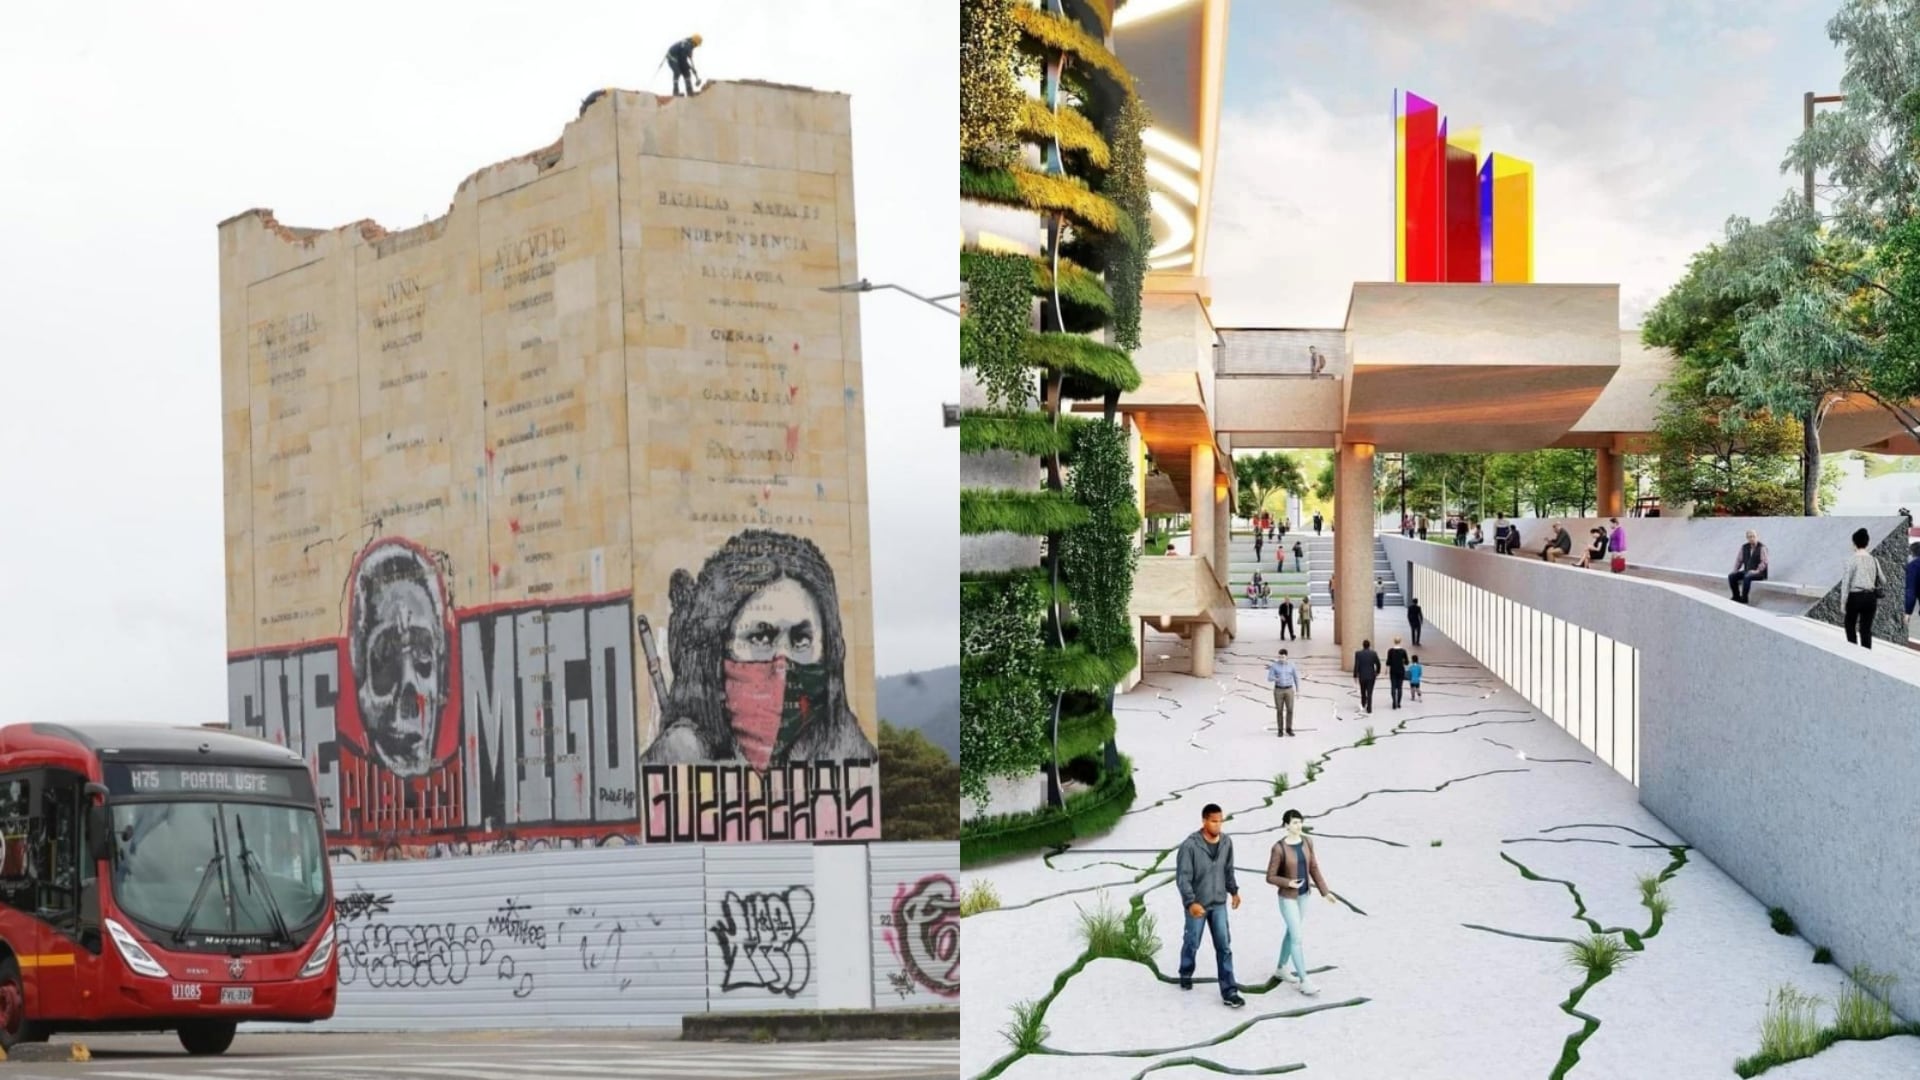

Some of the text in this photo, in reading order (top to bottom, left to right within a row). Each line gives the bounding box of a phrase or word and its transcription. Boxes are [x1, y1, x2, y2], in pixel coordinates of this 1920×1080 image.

[131, 771, 267, 791] H75 PORTAL USME
